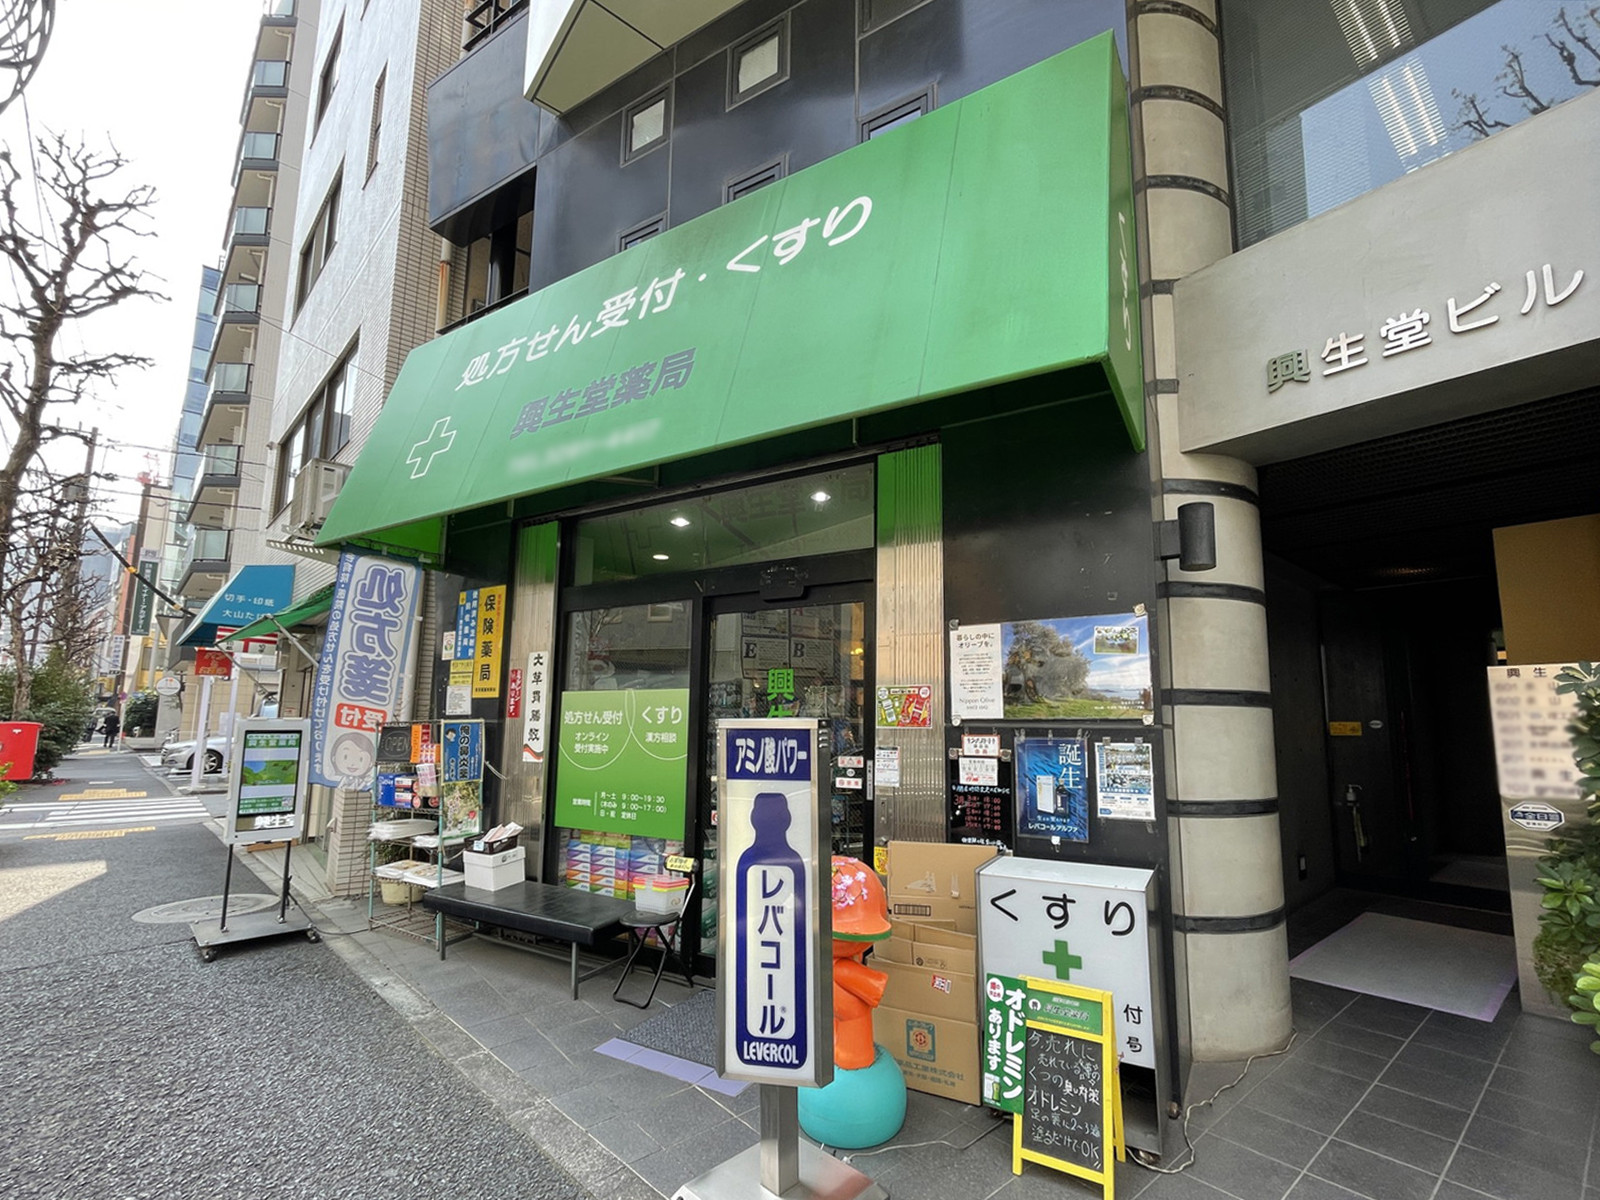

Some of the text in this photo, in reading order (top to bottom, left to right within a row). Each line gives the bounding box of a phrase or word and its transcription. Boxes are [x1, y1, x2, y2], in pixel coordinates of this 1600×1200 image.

[454, 195, 873, 391] 処方せん受付・くすり
[1267, 263, 1585, 394] 興生堂ビル
[509, 347, 697, 440] 興生堂薬局
[224, 593, 275, 607] 切手・印紙
[479, 594, 496, 681] 保険薬局
[564, 710, 623, 725] 処方せん受付
[574, 732, 610, 742] オンライン
[642, 705, 683, 725] くすり
[735, 737, 807, 775] アミノ酸パワー
[1058, 743, 1082, 789] 誕生
[989, 888, 1136, 937] くすり
[743, 1040, 799, 1065] LEVERCOL
[986, 1006, 1003, 1072] あります
[1002, 986, 1027, 1100] オドレミン
[1027, 1085, 1082, 1116] オドレミン
